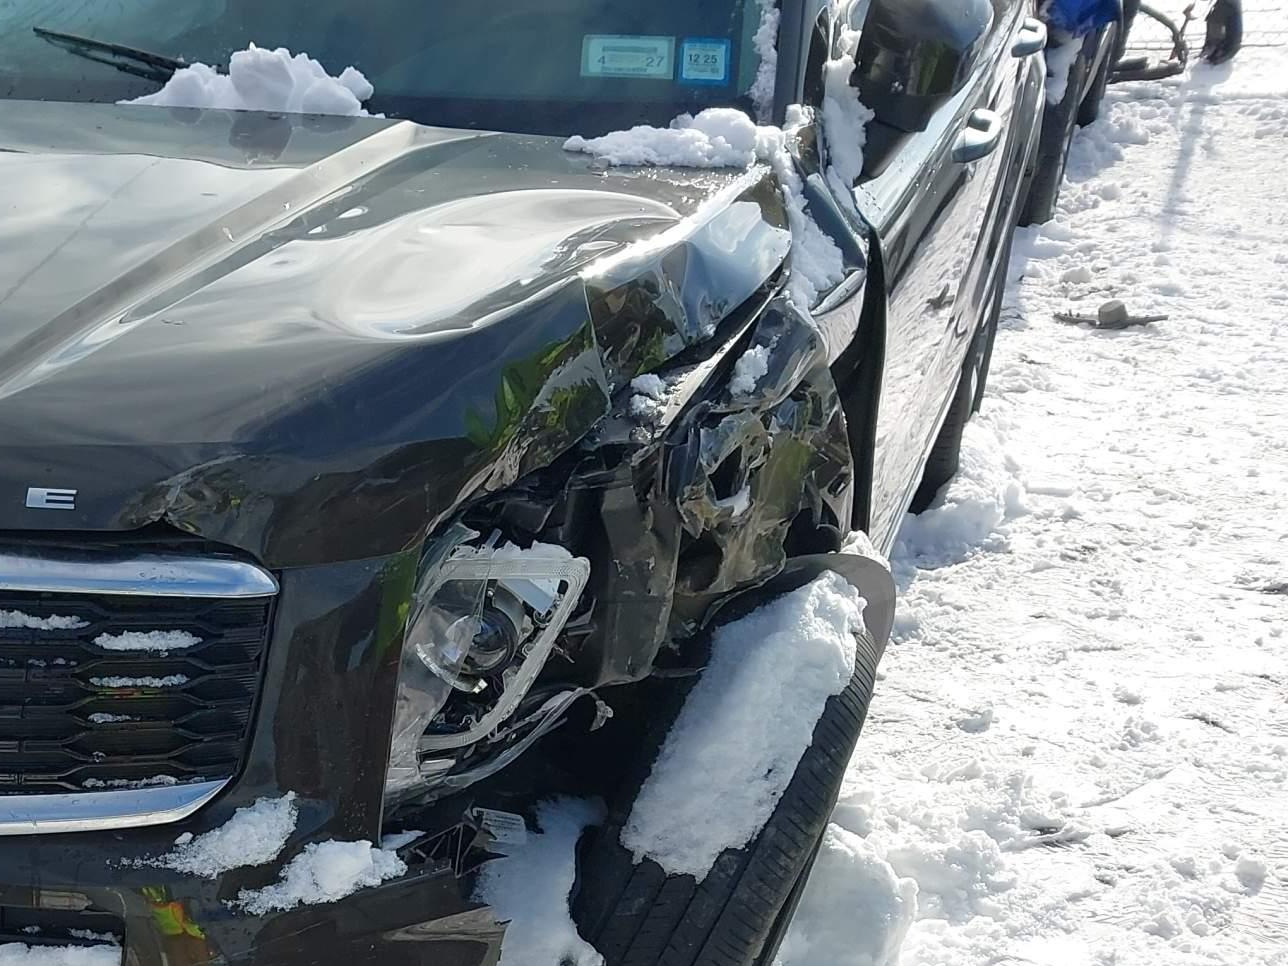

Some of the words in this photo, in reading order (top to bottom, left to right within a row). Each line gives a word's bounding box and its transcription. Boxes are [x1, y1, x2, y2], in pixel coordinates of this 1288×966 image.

[645, 56, 665, 68] 27
[688, 53, 700, 63] 12
[703, 54, 718, 64] 25
